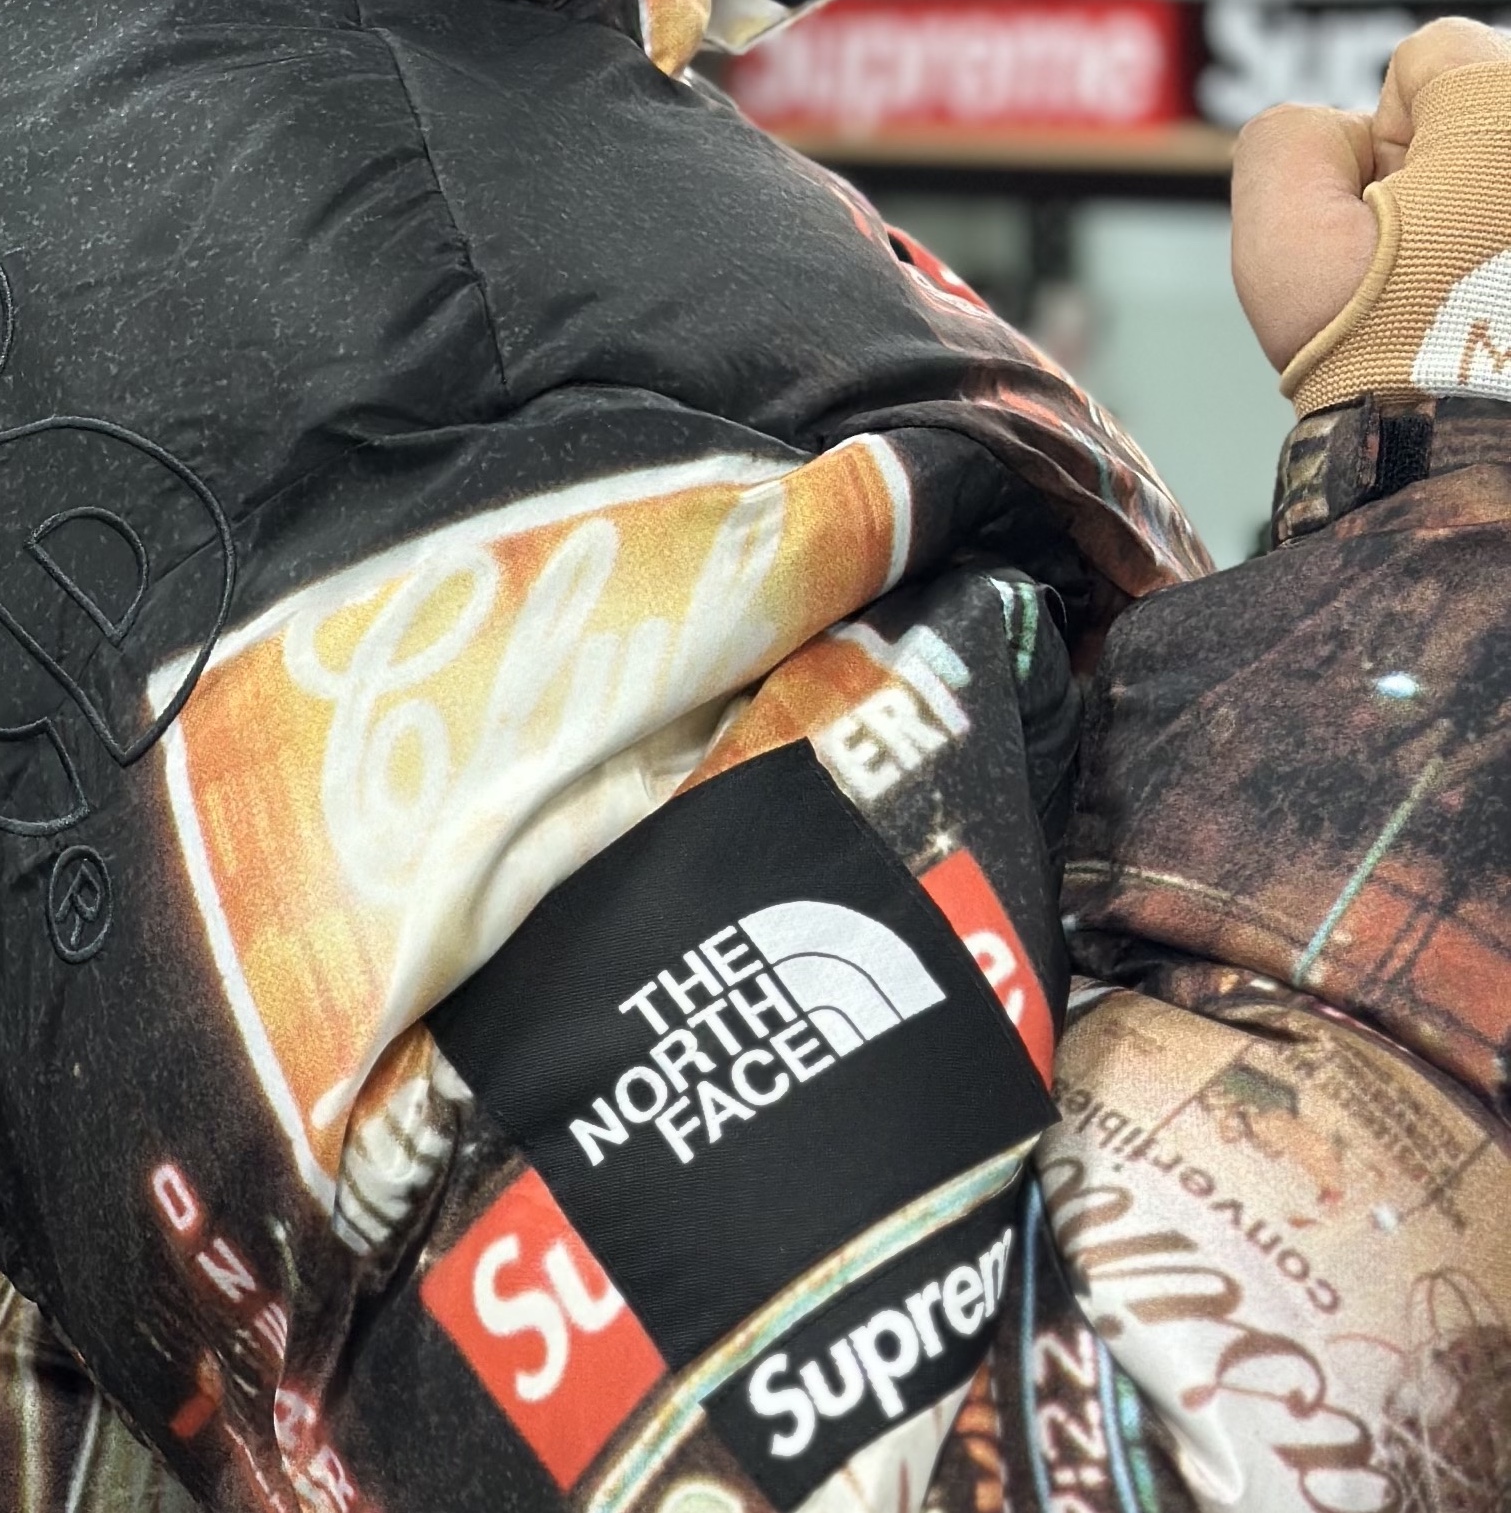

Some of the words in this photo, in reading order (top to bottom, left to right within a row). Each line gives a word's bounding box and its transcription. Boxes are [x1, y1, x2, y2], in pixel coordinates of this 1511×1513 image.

[618, 925, 764, 1036] THE
[568, 972, 799, 1168] NORTH
[654, 1019, 837, 1165] FACE
